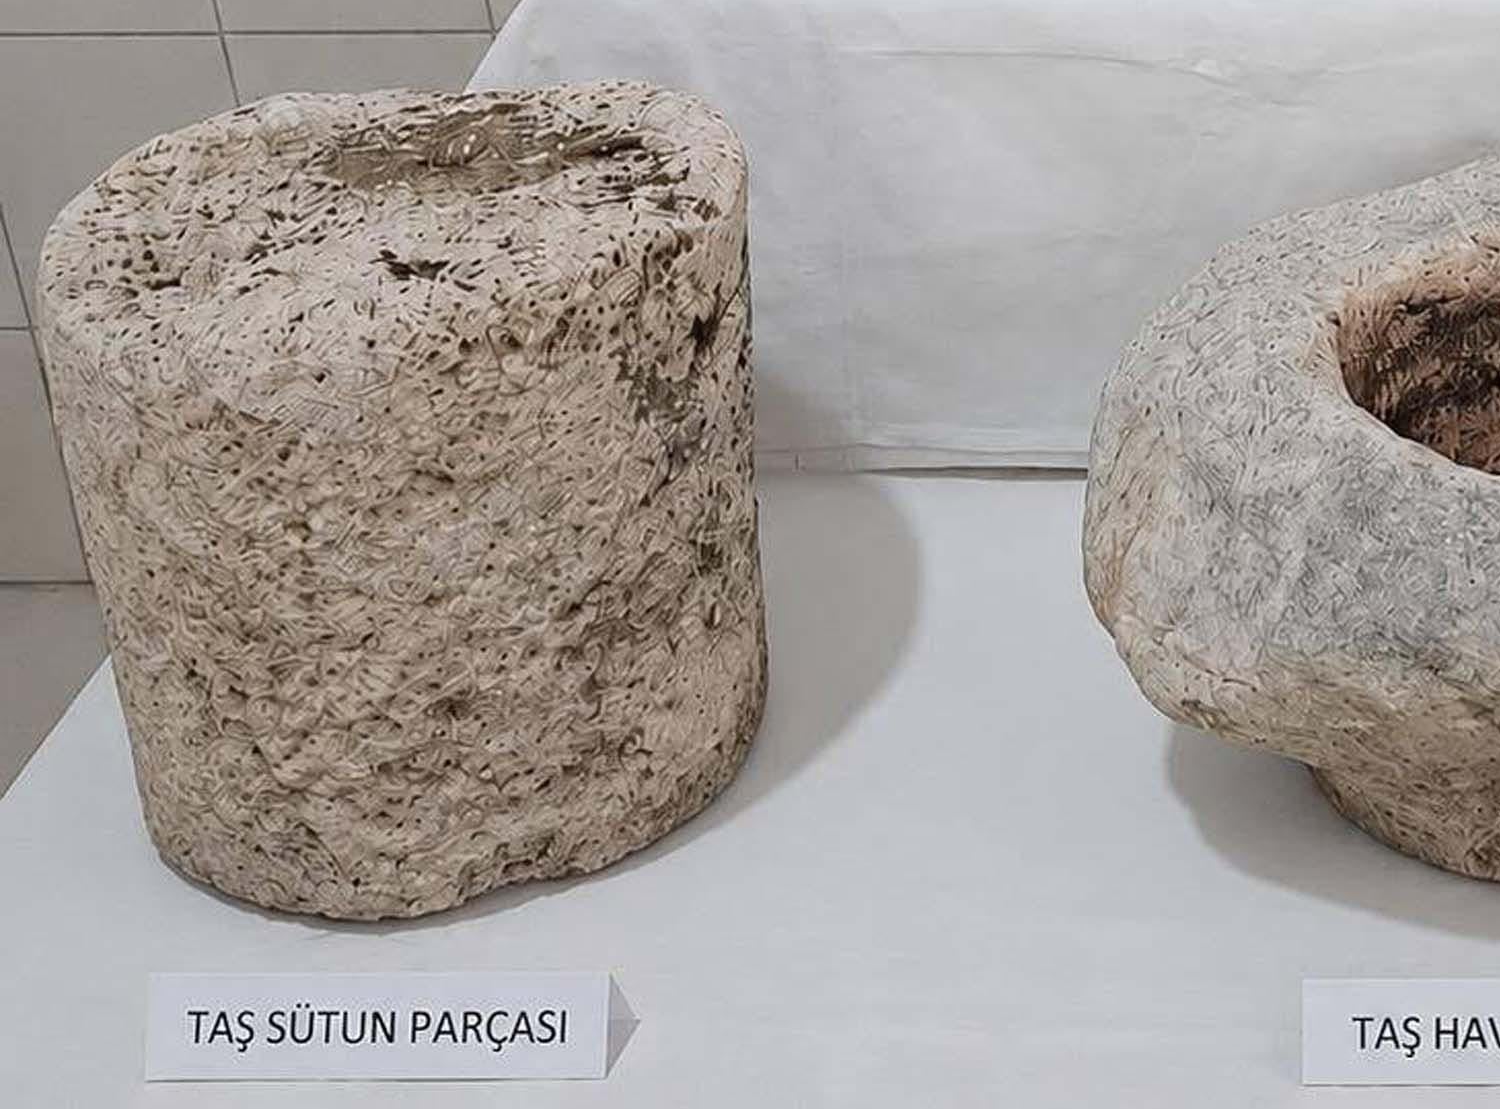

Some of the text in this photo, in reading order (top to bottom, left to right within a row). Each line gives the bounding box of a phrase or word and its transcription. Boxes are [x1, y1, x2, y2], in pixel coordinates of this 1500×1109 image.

[187, 1003, 567, 1053] TAŞ SÜTUN PARÇASI
[1352, 1016, 1421, 1058] TAŞ
